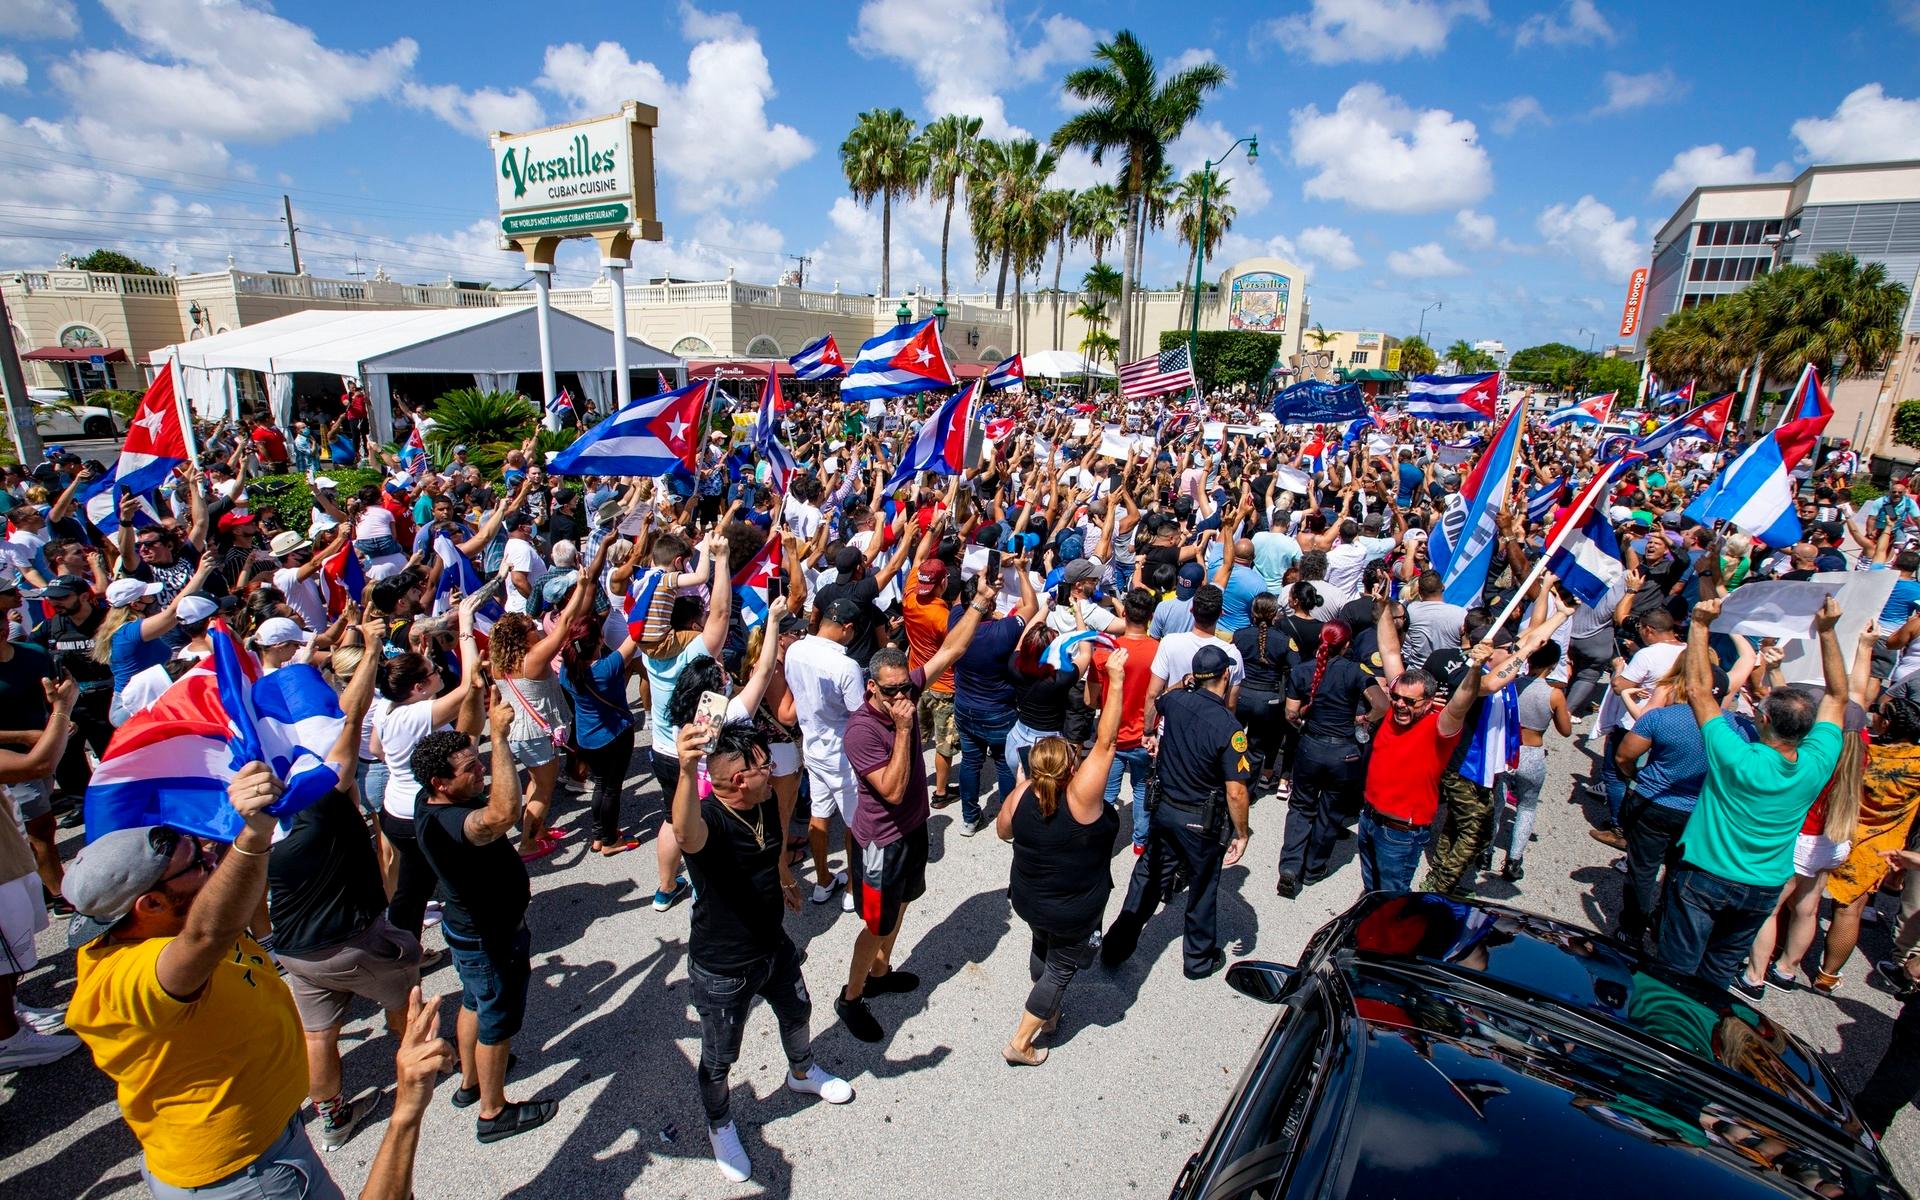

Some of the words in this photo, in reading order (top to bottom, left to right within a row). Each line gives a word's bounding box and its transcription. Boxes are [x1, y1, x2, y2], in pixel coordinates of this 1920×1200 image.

[502, 134, 615, 199] Versailles
[548, 183, 578, 198] CUBAN
[579, 179, 616, 195] CUISINE
[510, 220, 518, 228] THE
[518, 219, 537, 227] WORLD'S
[537, 218, 550, 226] MOST
[550, 216, 568, 224] FAMOUS
[568, 214, 584, 223] CUBAN
[585, 210, 615, 220] RESTAURANT
[1235, 279, 1288, 290] Versailles
[1629, 272, 1645, 305] Storage
[1623, 307, 1636, 334] Public
